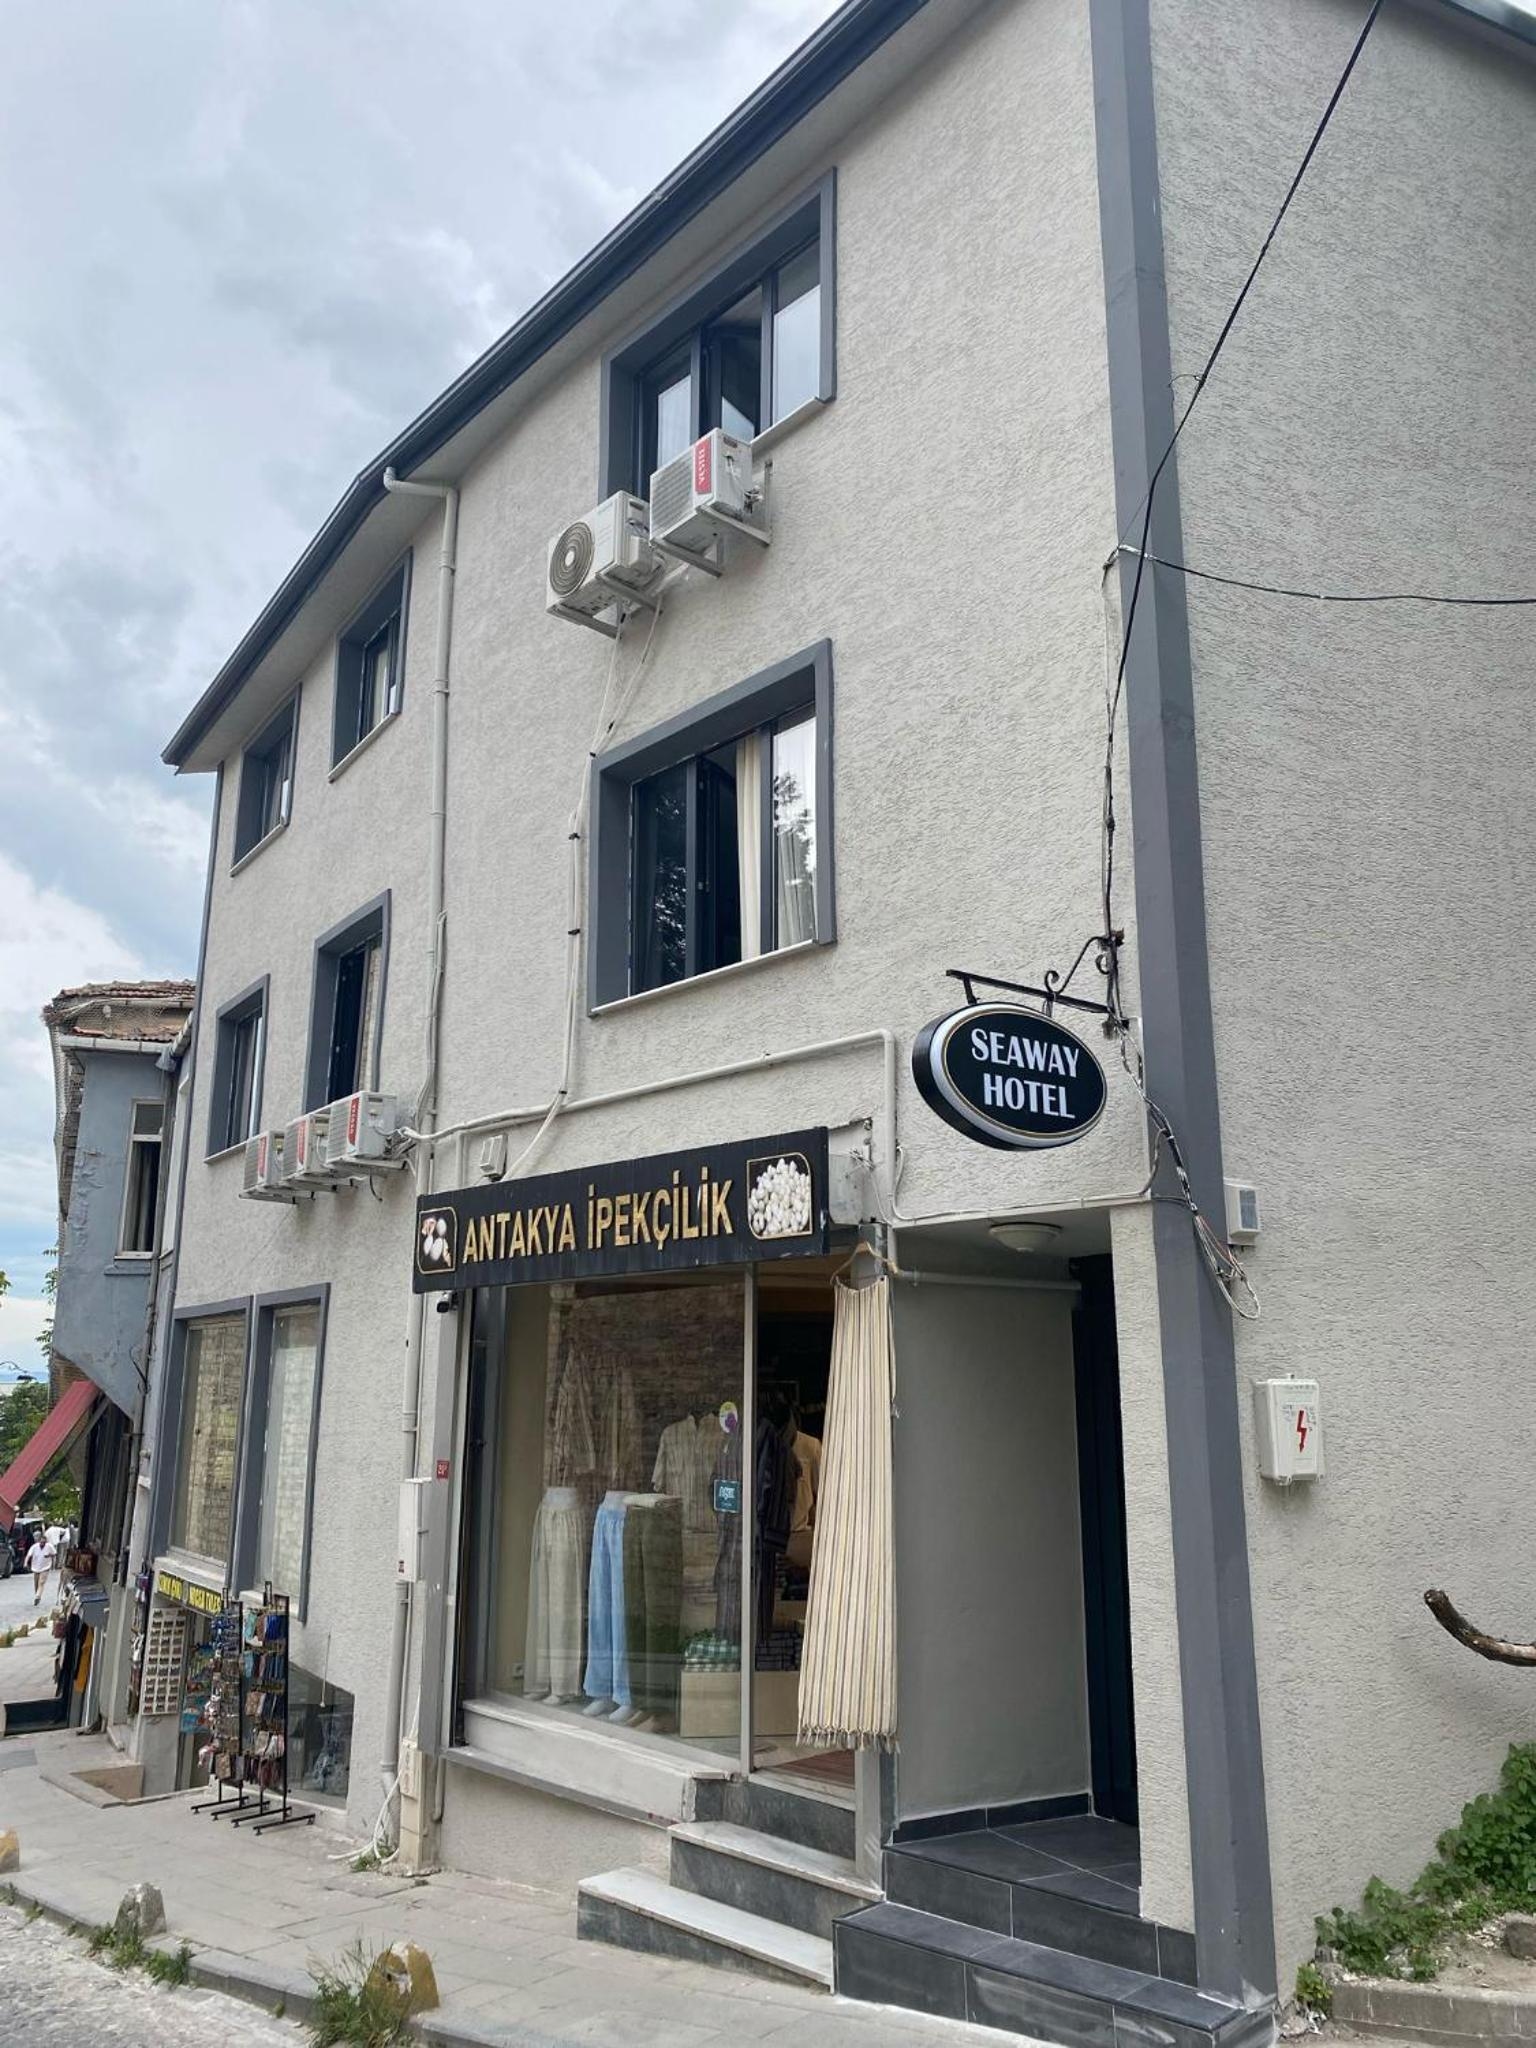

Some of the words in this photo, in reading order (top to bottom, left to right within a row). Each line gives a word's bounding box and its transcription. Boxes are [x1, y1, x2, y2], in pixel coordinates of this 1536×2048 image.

[971, 1028, 1079, 1078] SEAWAY
[983, 1073, 1076, 1119] HOTEL
[462, 1202, 576, 1264] ANTAKYA
[587, 1166, 733, 1251] İPEKÇİLİK
